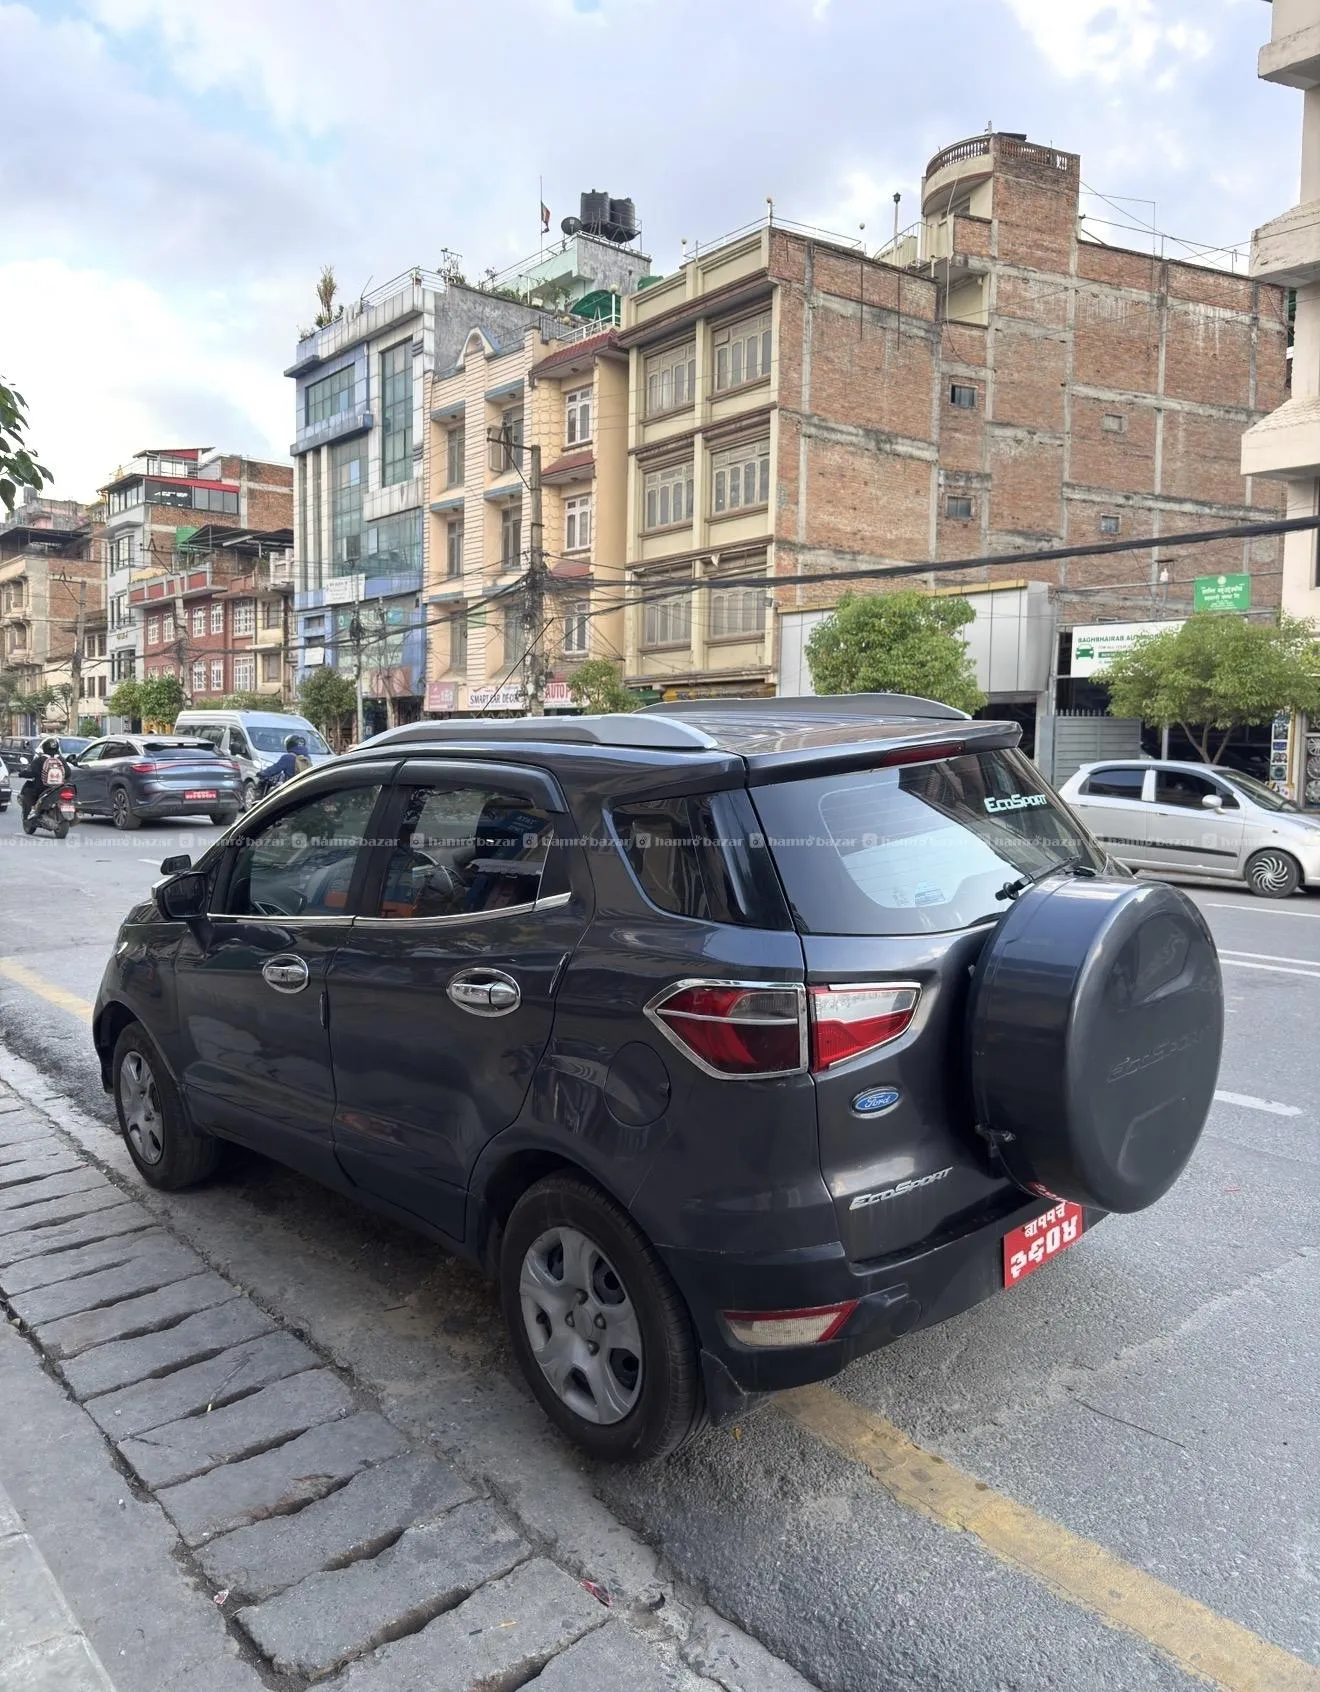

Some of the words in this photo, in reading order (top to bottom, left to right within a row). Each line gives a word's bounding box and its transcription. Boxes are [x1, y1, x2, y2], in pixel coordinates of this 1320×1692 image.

[545, 683, 564, 699] AUTO
[470, 694, 489, 705] SMART
[864, 1094, 890, 1109] Ford
